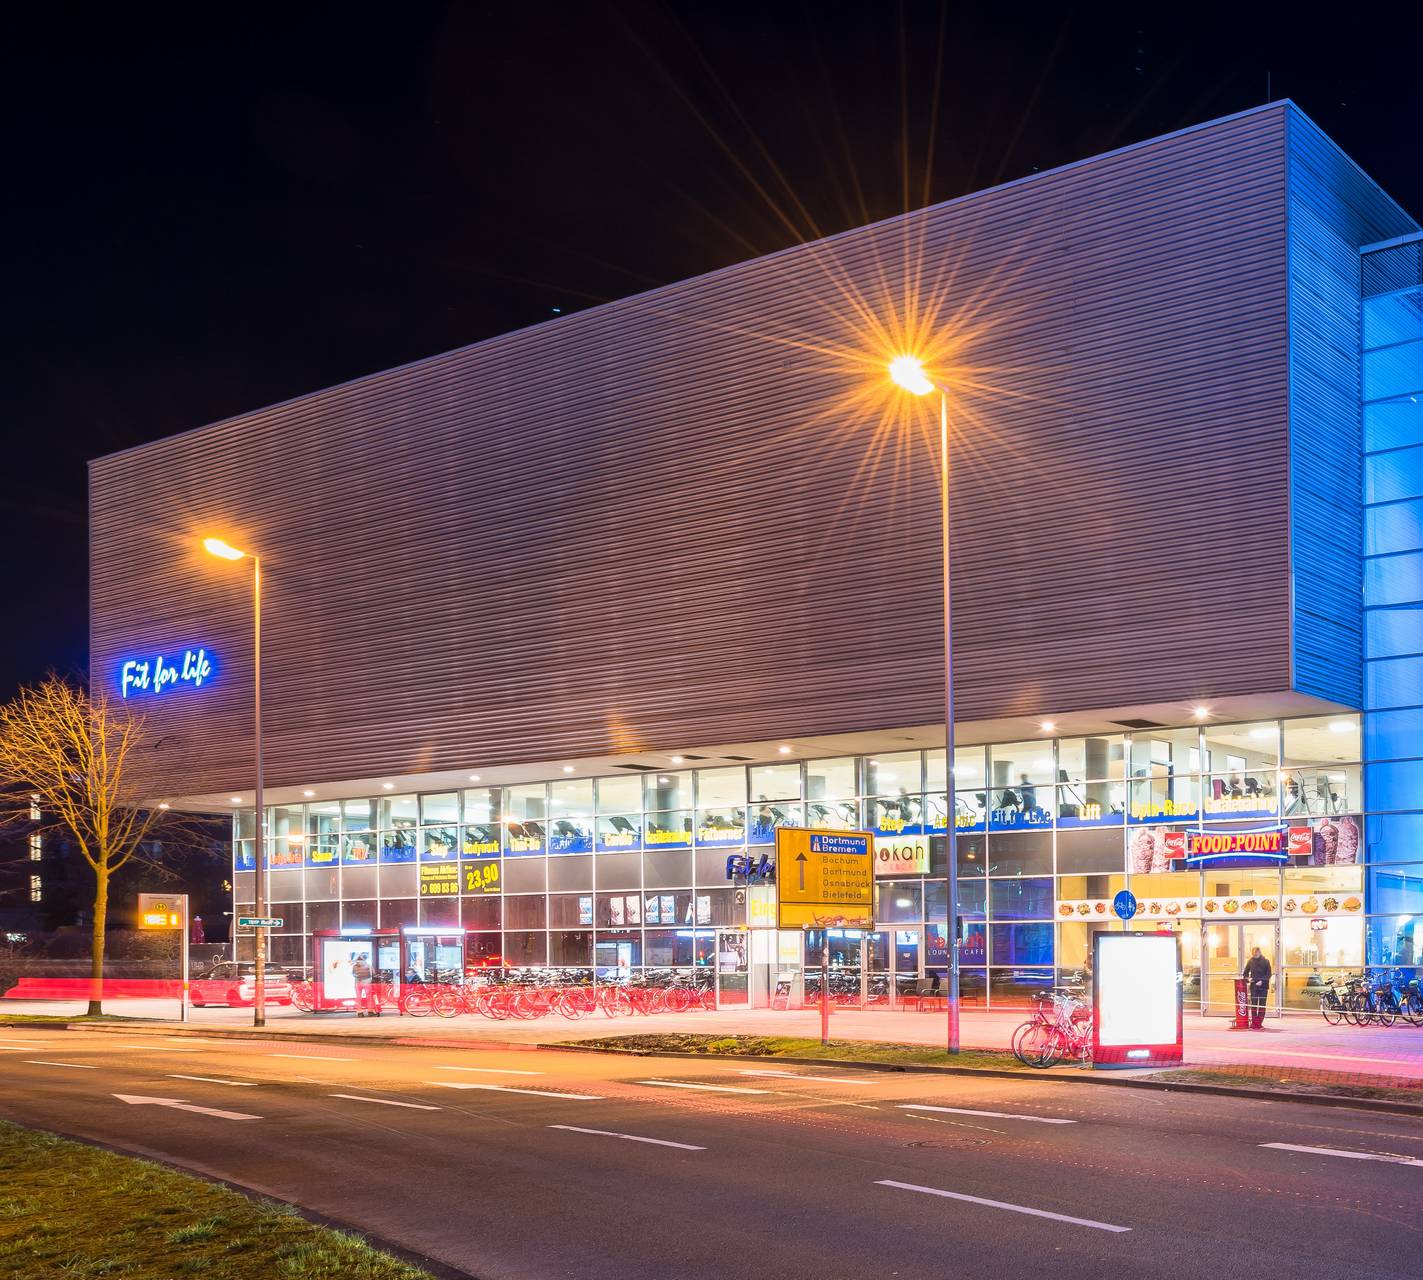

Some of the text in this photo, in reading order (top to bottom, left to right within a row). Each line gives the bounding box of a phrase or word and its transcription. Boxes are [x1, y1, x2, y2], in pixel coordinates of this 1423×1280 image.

[122, 648, 211, 698] Fit for life
[933, 813, 976, 829] Aebic
[822, 836, 866, 846] Dortmund
[1192, 832, 1280, 854] FOOD-POINT
[822, 844, 857, 853] Bremen
[822, 856, 859, 865] Bochum
[466, 863, 499, 890] 23,90
[822, 867, 867, 877] Dortmund
[822, 879, 871, 888] Osnabrück
[822, 890, 862, 899] Bielefeld
